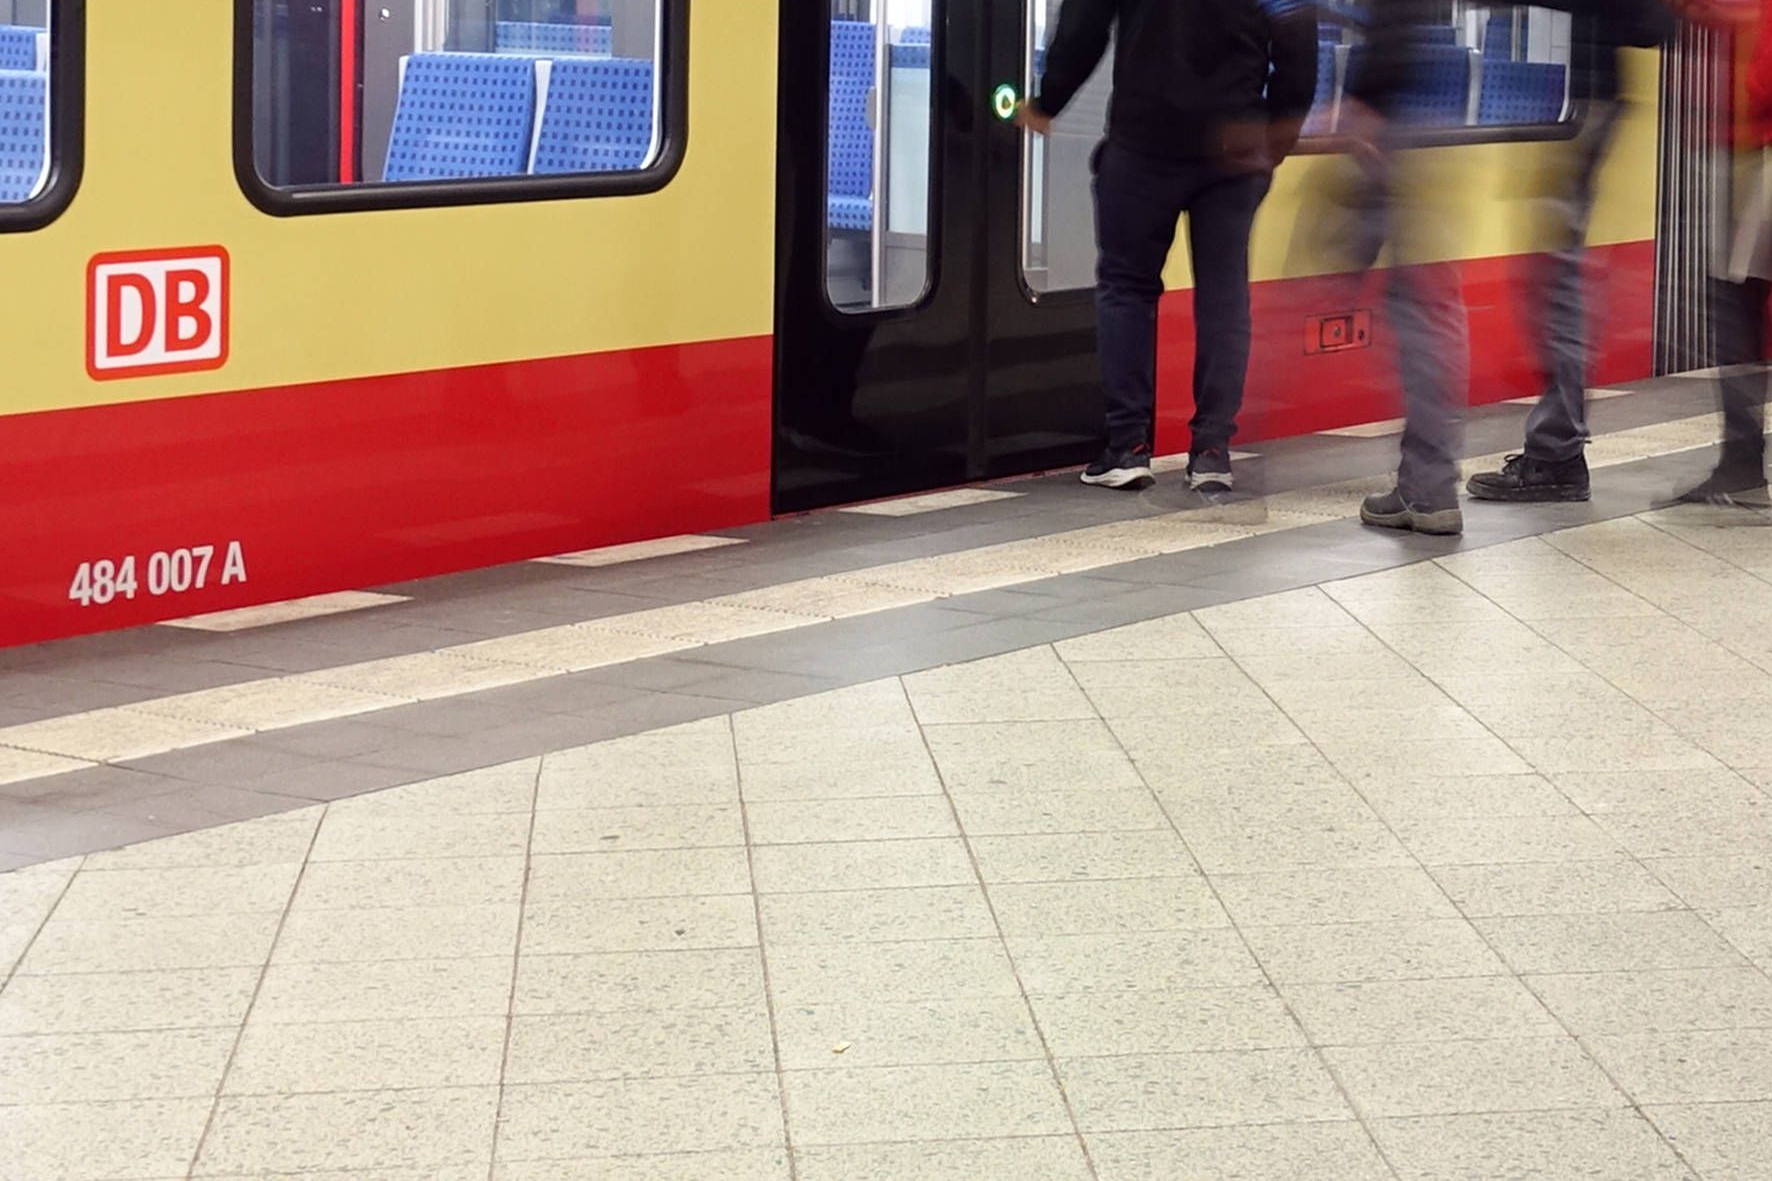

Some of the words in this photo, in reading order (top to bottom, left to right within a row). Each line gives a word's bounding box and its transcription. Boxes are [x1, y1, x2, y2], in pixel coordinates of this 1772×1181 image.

[106, 268, 212, 358] DB
[68, 556, 137, 607] 484
[147, 544, 215, 596] 007
[221, 540, 248, 586] A
